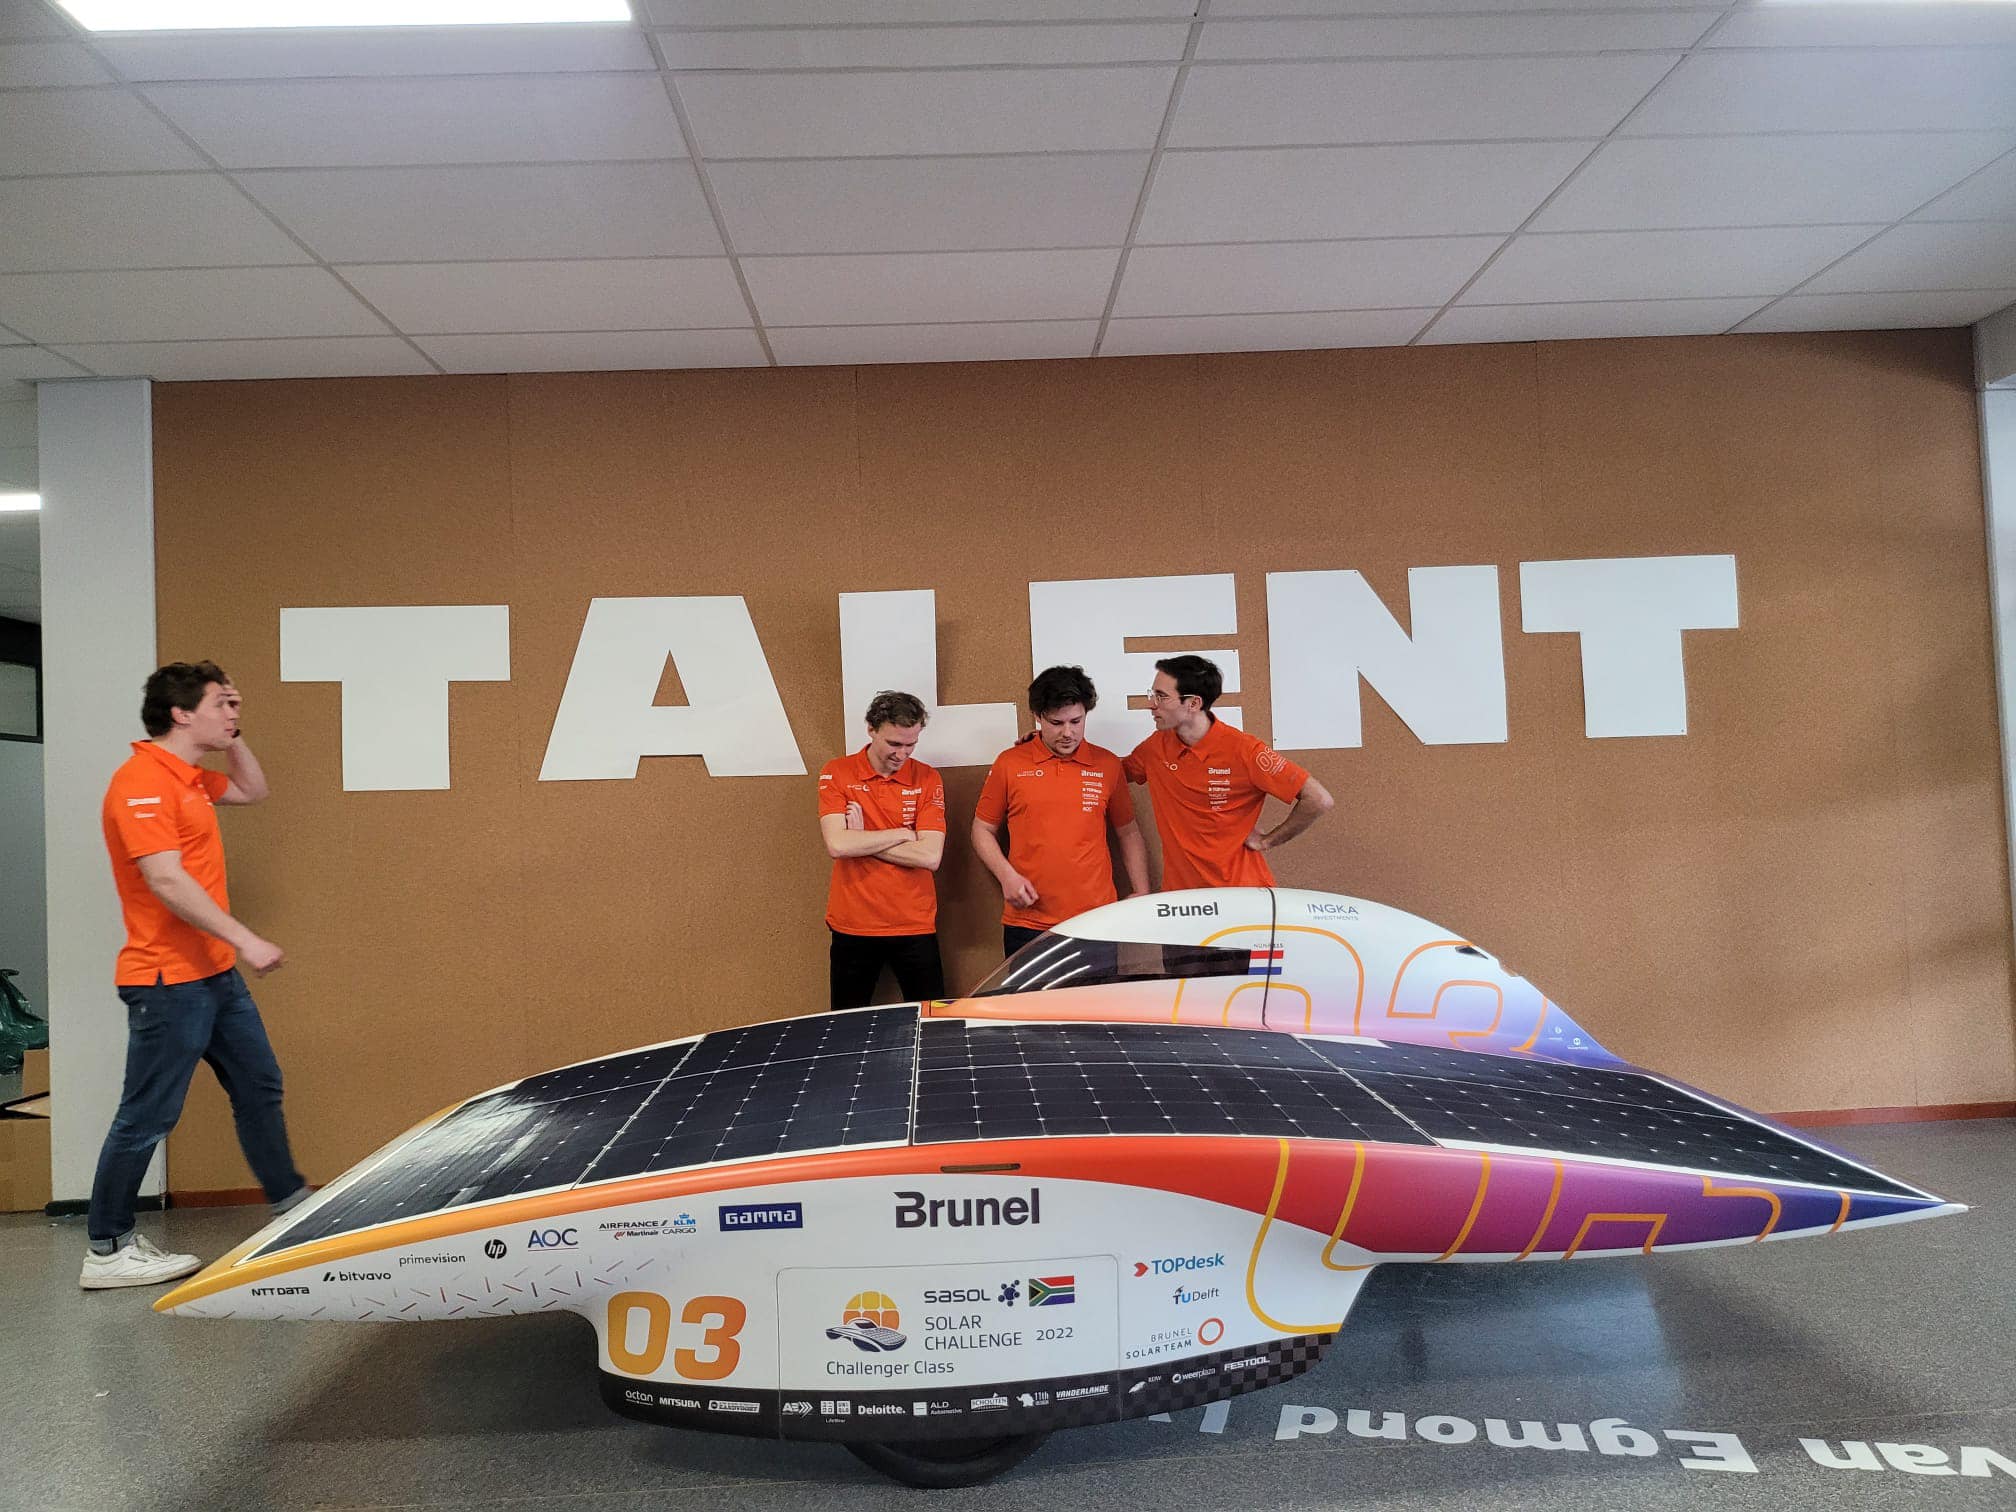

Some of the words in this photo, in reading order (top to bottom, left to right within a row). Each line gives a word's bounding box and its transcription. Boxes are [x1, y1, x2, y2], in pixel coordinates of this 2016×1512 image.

[280, 553, 1740, 792] TALENT
[1156, 902, 1219, 918] Brunel
[1306, 903, 1359, 914] INGKA
[893, 1187, 1040, 1228] Brunel
[673, 1217, 696, 1226] KLM
[527, 1229, 579, 1250] AOC
[626, 1229, 659, 1238] Martinair
[662, 1227, 697, 1235] CARGO
[486, 1239, 507, 1259] hp
[399, 1252, 466, 1268] primevision
[1151, 1253, 1225, 1275] TOPdesk
[339, 1271, 392, 1282] bitvavo
[1192, 1288, 1220, 1302] Delft
[925, 1315, 982, 1330] SOLAR
[608, 1291, 747, 1380] 03
[924, 1332, 1022, 1350] CHALLENGE
[1036, 1327, 1074, 1341] 2022
[1151, 1328, 1192, 1342] BRUNEL
[1125, 1346, 1161, 1360] SOLAR
[1163, 1340, 1192, 1352] TEAM
[826, 1361, 909, 1378] Challenger
[914, 1361, 954, 1374] Class
[1224, 1356, 1270, 1371] FESTOOL
[1182, 1368, 1216, 1380] weerplaza
[1056, 1385, 1110, 1399] VANDERLANDE
[659, 1397, 701, 1409] MITSUBA
[858, 1404, 906, 1416] Deloitte.
[930, 1401, 950, 1409] ALD
[1275, 1404, 1760, 1473] Egmond
